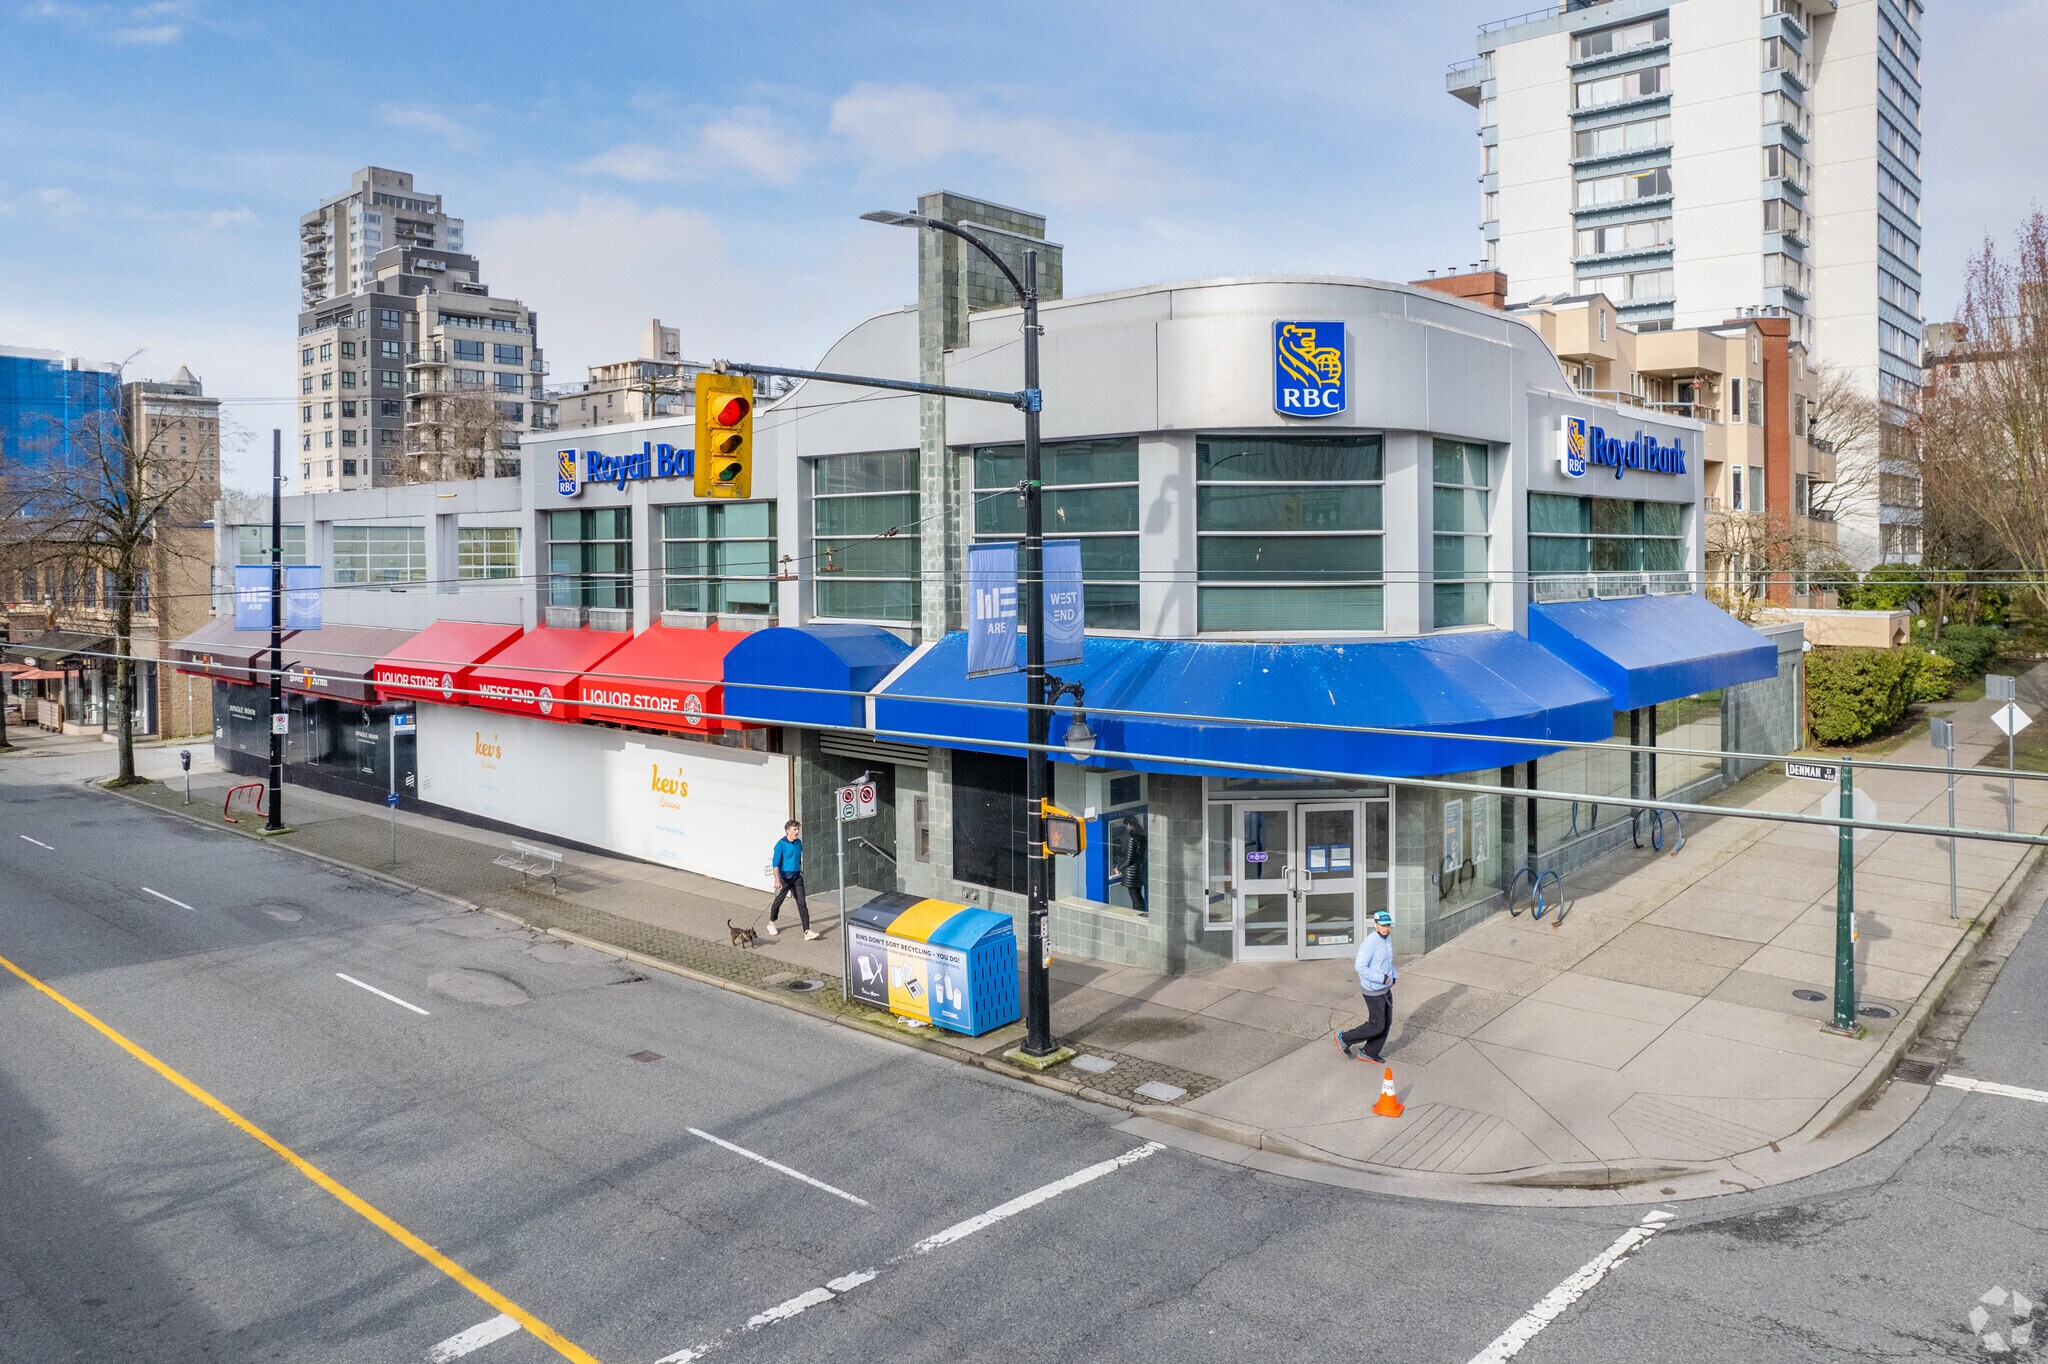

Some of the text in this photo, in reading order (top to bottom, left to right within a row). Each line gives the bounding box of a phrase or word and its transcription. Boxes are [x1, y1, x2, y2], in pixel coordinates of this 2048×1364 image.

[1283, 388, 1339, 408] RBC
[1589, 426, 1686, 480] Royal Bank
[586, 441, 695, 491] Royal Ba
[1569, 459, 1584, 472] RBC
[560, 481, 575, 492] RBC
[1050, 592, 1077, 605] WEST
[1053, 609, 1075, 621] END
[987, 622, 1006, 634] ARE
[377, 671, 409, 686] LIQUOR
[410, 675, 439, 688] STORE
[479, 683, 510, 701] WEST
[511, 687, 535, 704] END
[582, 688, 631, 708] LIQUOR
[634, 694, 679, 711] STORE
[475, 731, 502, 759] kev's
[651, 763, 688, 798] kev's
[1790, 764, 1820, 777] DENMAN
[868, 936, 885, 945] DON'T
[885, 940, 900, 948] SORT
[901, 944, 931, 956] RECYCLING
